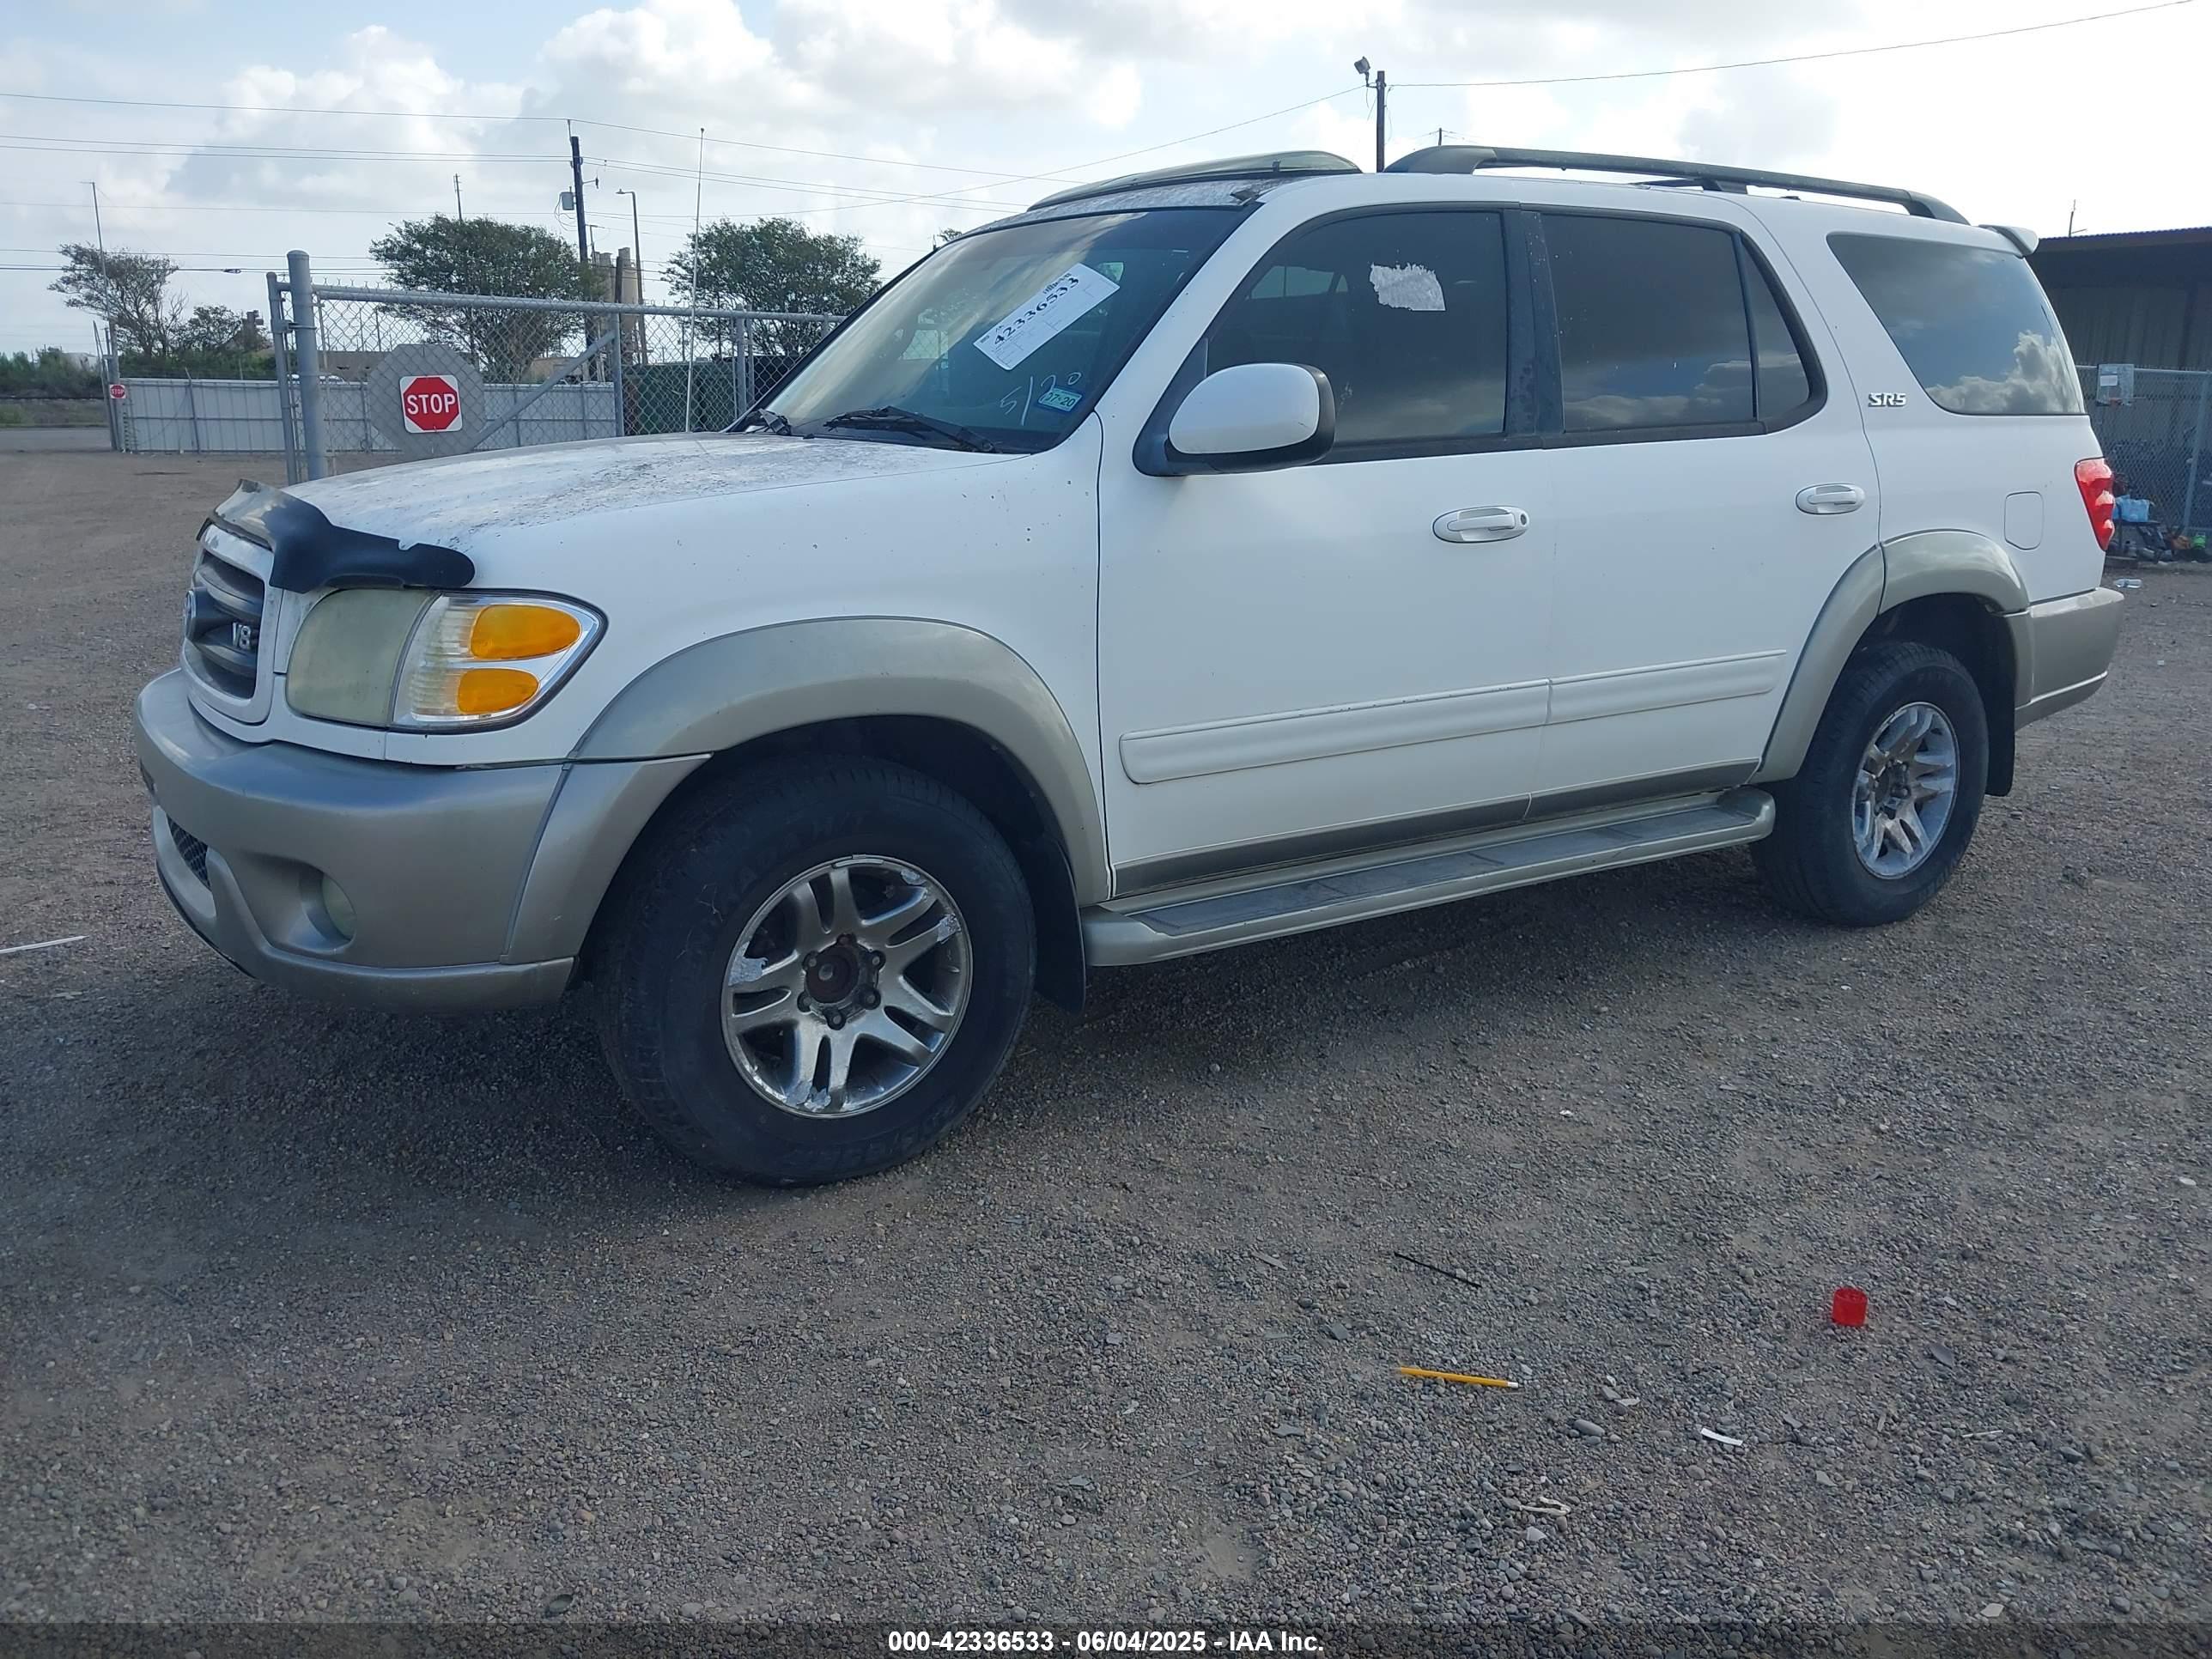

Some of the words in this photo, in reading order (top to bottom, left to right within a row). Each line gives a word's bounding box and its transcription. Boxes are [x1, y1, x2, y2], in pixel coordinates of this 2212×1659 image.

[994, 276, 1079, 346] 42336533
[407, 393, 456, 415] STOP
[1868, 392, 1906, 407] SR5
